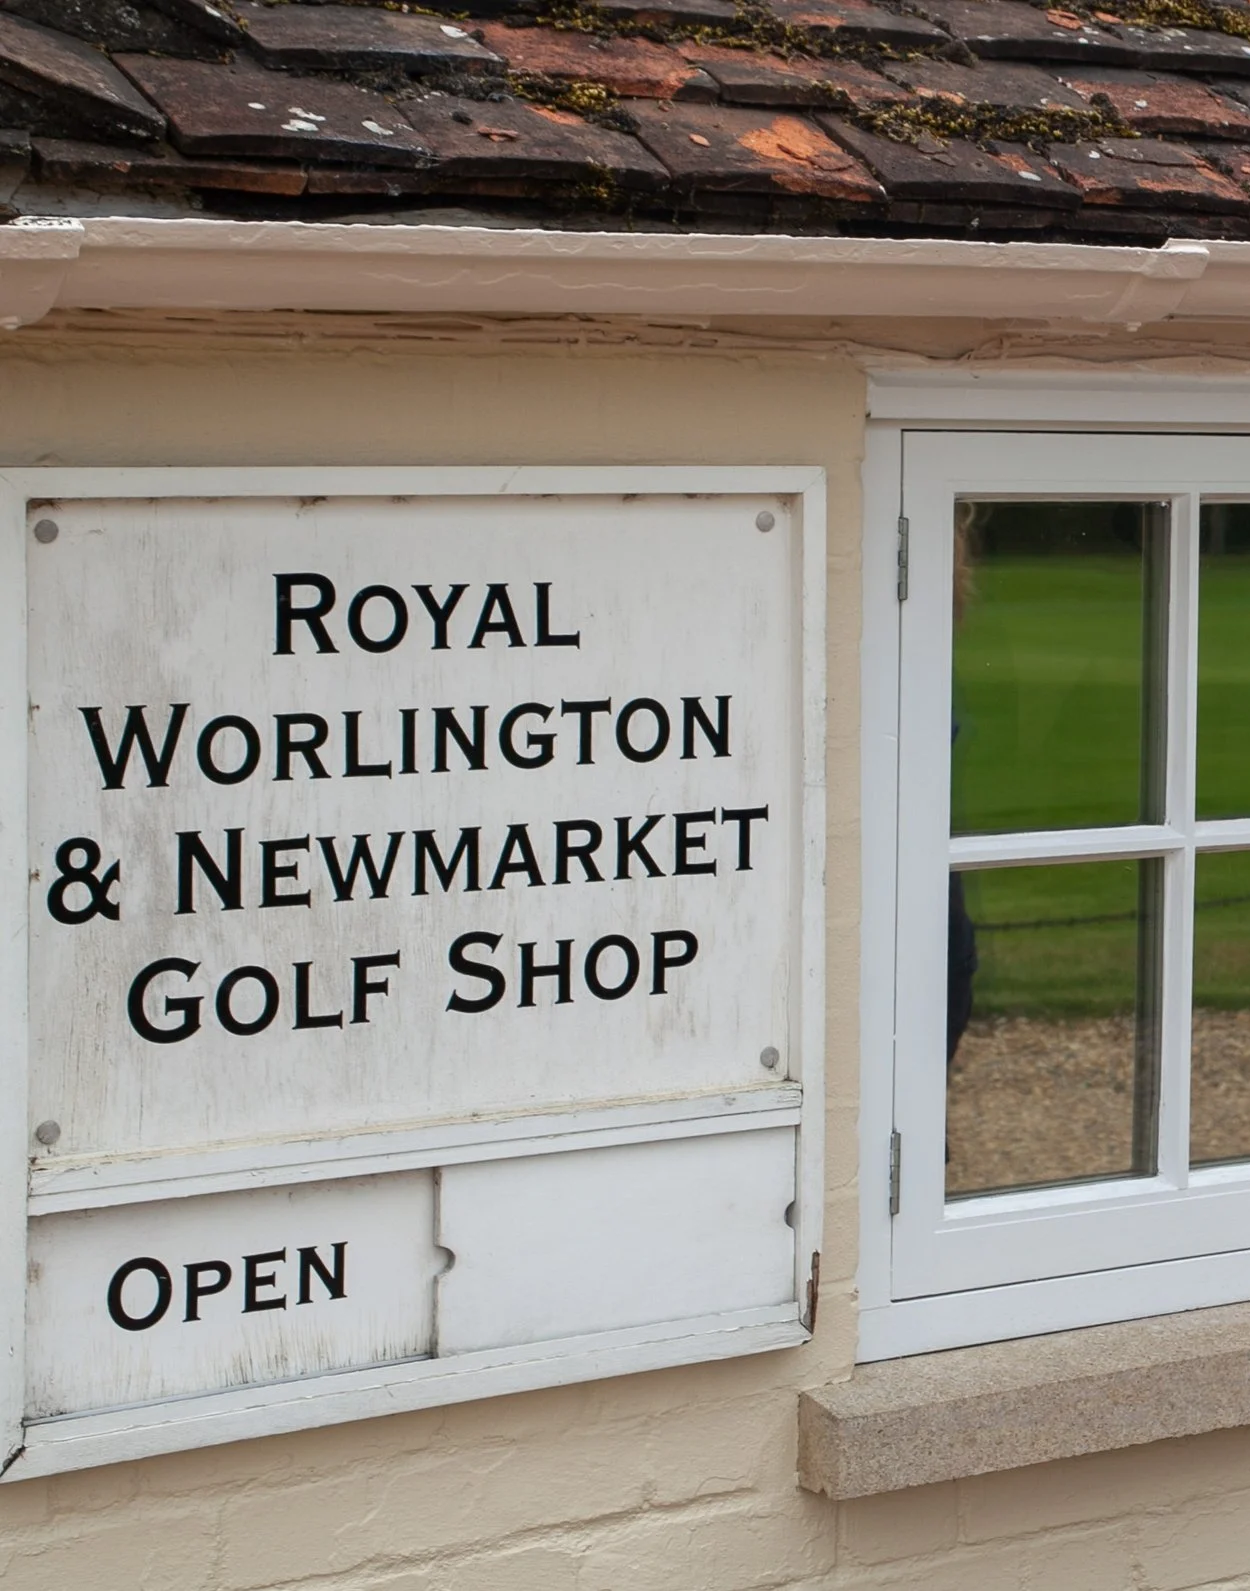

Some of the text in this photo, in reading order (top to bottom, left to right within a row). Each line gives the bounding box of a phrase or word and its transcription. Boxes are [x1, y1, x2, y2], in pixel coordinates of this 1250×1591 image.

[274, 573, 579, 655] ROYAL
[79, 696, 731, 790] WORLINGTON
[48, 805, 768, 924] & NEWMARKET
[128, 931, 698, 1043] GOLF SHOP
[108, 1242, 347, 1330] OPEN
